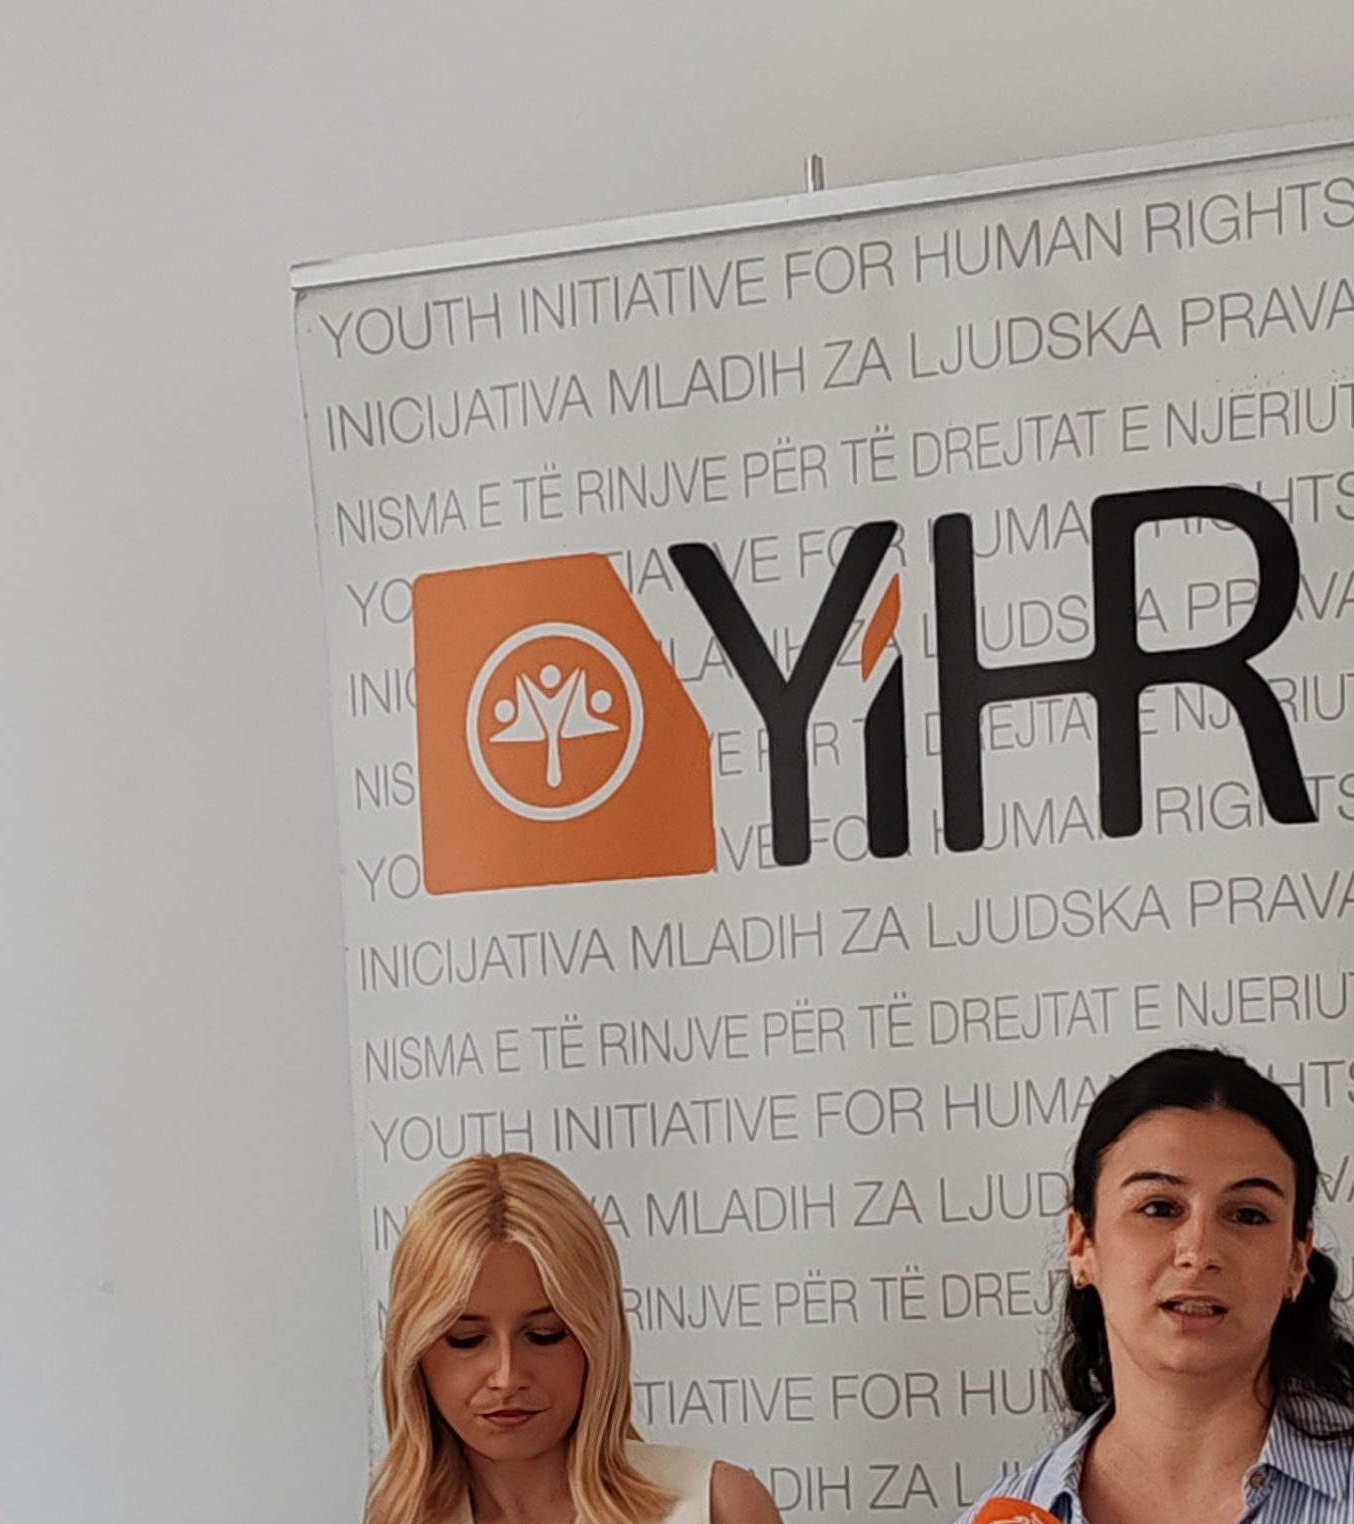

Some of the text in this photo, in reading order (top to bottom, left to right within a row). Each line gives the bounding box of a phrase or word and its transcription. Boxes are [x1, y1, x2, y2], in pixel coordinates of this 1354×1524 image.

[320, 293, 502, 359] YOUTH
[521, 257, 768, 335] INITIATIVE
[785, 240, 895, 300] FOR
[915, 208, 1123, 283] HUMAN
[327, 374, 593, 452] INICIJATIVA
[609, 346, 806, 416] MLADIH
[824, 336, 892, 389] ZA
[910, 303, 1162, 380] LJUDSKA
[336, 489, 467, 546] NISMA
[479, 481, 503, 528] E
[513, 462, 564, 522] TË
[578, 455, 729, 516] RINJVE
[743, 436, 828, 499] PËR
[840, 424, 898, 485] TË
[912, 408, 1107, 478] DREJTAT
[1122, 405, 1150, 453] E
[928, 499, 1090, 564] UMA
[923, 587, 1168, 659] LUDSA
[356, 760, 416, 811] NIS
[933, 794, 1103, 855] UMA
[360, 927, 616, 992] INICIJATIVA
[631, 910, 823, 971] MLADIH
[841, 905, 911, 955] ZA
[928, 882, 1172, 949] LJUDSKA
[365, 1032, 484, 1083] NISMA
[496, 1028, 521, 1074] E
[532, 1013, 585, 1070] TË
[599, 1014, 750, 1067] RINJVE
[763, 998, 846, 1057] PËR
[858, 991, 915, 1049] TË
[929, 986, 1120, 1046] DREJTAT
[1133, 984, 1161, 1031] E
[370, 1109, 534, 1163] YOUTH
[553, 1095, 799, 1153] INITIATIVE
[816, 1086, 924, 1139] FOR
[945, 1073, 1118, 1131] HUMA
[646, 1182, 837, 1239] MLADIH
[853, 1178, 923, 1228] ZA
[939, 1171, 1073, 1223] LJUD
[776, 1268, 858, 1326] PËR
[871, 1264, 926, 1322] TË
[941, 1268, 1071, 1319] DREJ
[633, 1376, 815, 1425] TIATIVE
[832, 1371, 940, 1421] FOR
[748, 1465, 852, 1512] DIH
[868, 1463, 939, 1510] ZA
